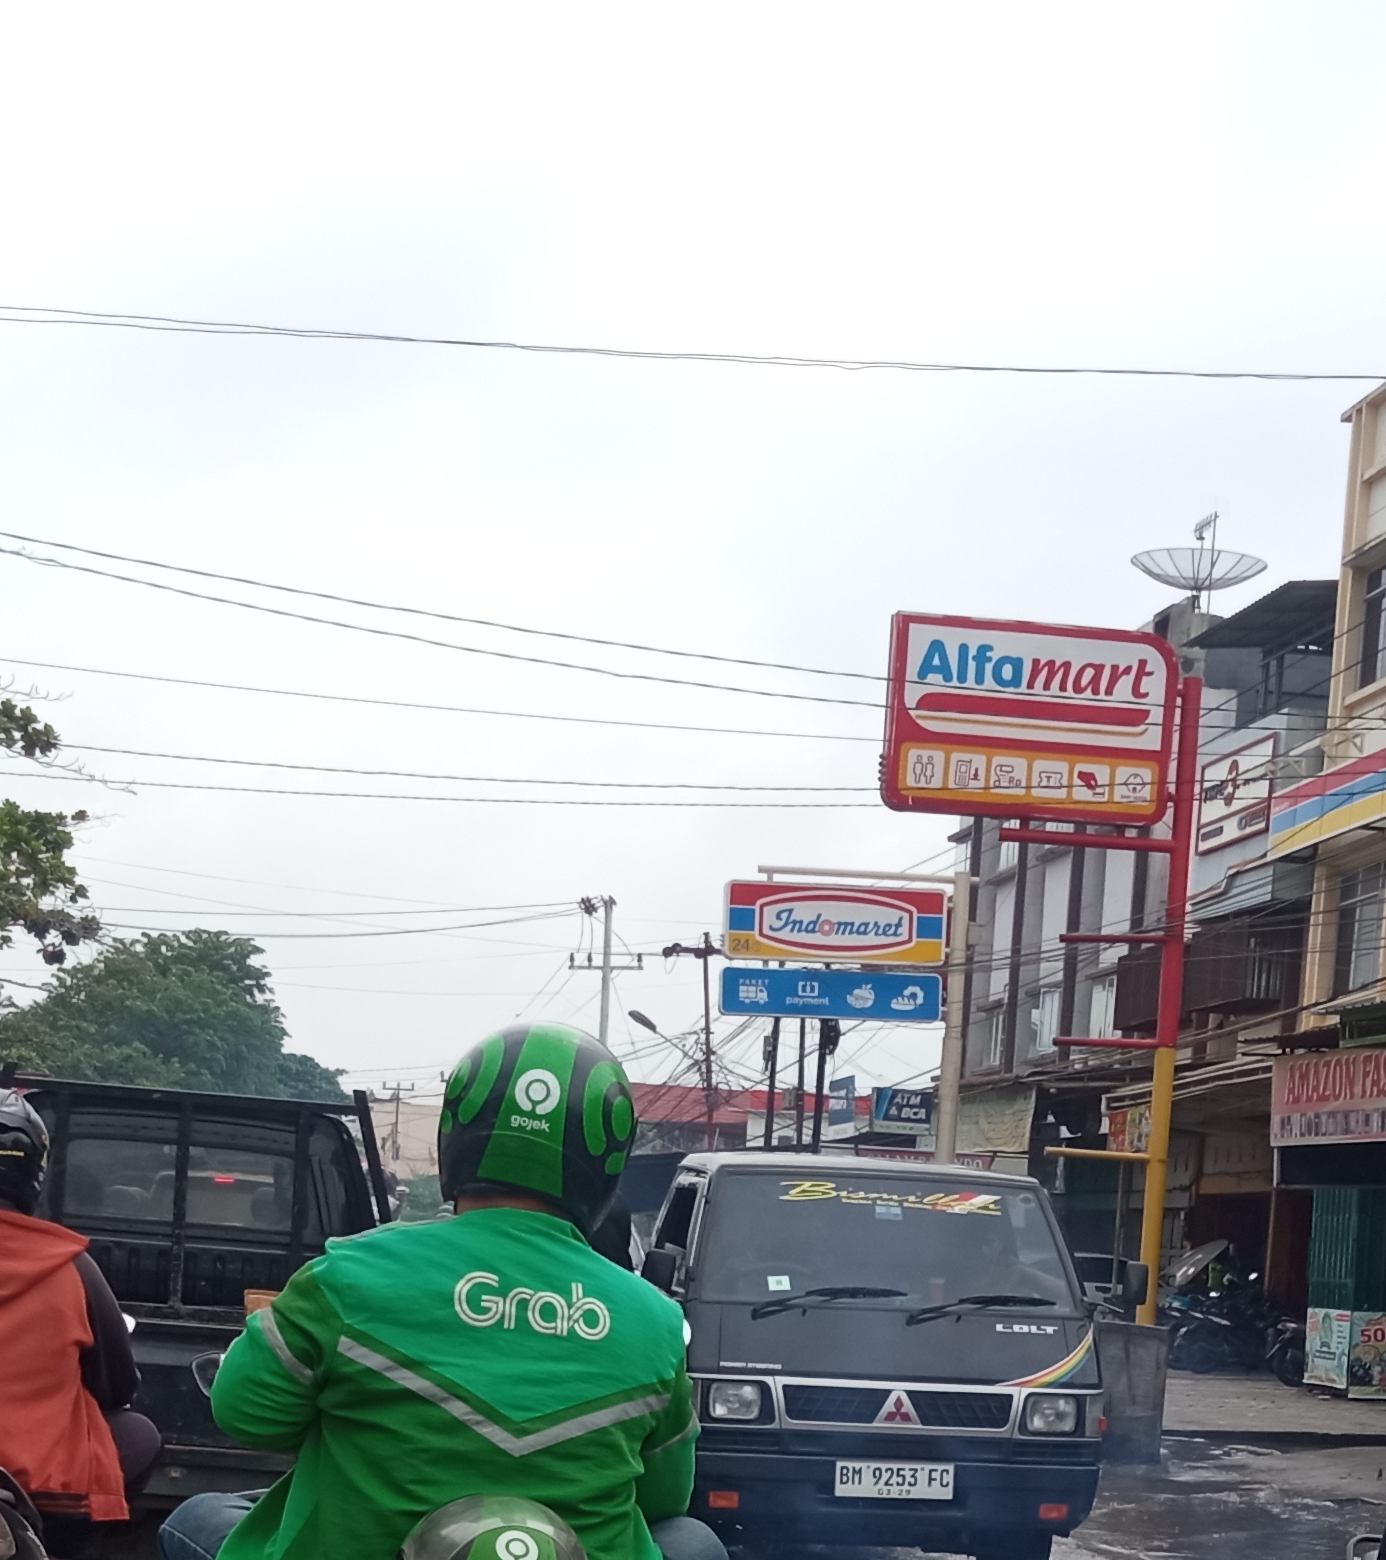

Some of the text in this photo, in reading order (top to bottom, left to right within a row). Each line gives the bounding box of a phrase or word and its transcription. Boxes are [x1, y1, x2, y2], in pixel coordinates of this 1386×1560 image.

[917, 639, 1155, 699] Alfamart
[769, 908, 904, 937] Indomaret
[786, 996, 829, 1005] payment
[1285, 1055, 1357, 1106] AMAZON
[893, 1093, 922, 1105] ATM
[510, 1113, 550, 1132] gojek
[900, 1107, 926, 1119] BCA
[454, 1271, 611, 1341] Grab
[995, 1324, 1058, 1334] COLT
[839, 1466, 950, 1488] BM 9253 FC
